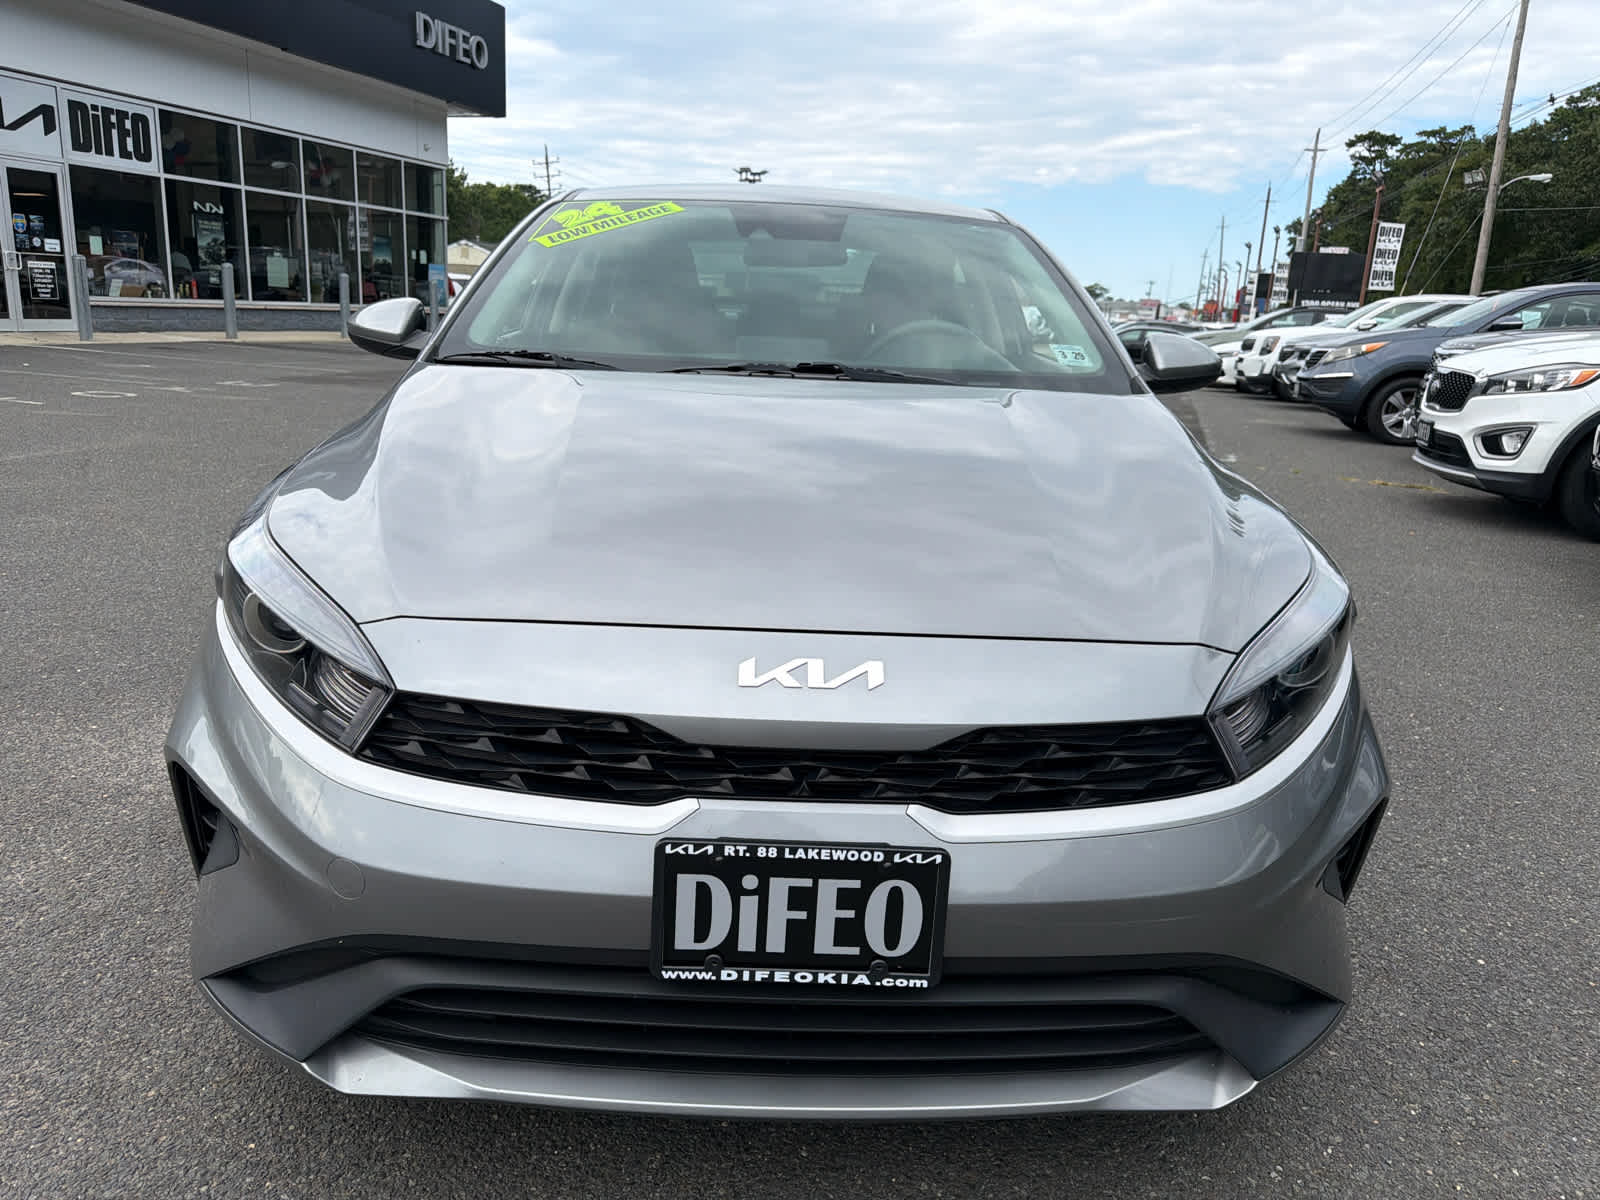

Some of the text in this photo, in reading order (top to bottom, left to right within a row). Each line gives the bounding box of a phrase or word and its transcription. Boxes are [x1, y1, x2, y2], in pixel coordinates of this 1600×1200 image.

[416, 11, 488, 69] DIFEO
[67, 99, 152, 163] DiFEO
[547, 204, 672, 243] LOW MILEAGE
[738, 656, 885, 691] KIA
[665, 843, 942, 865] KIA RT. 88 LAKEWOOD KIA
[674, 873, 923, 958] DiFEO
